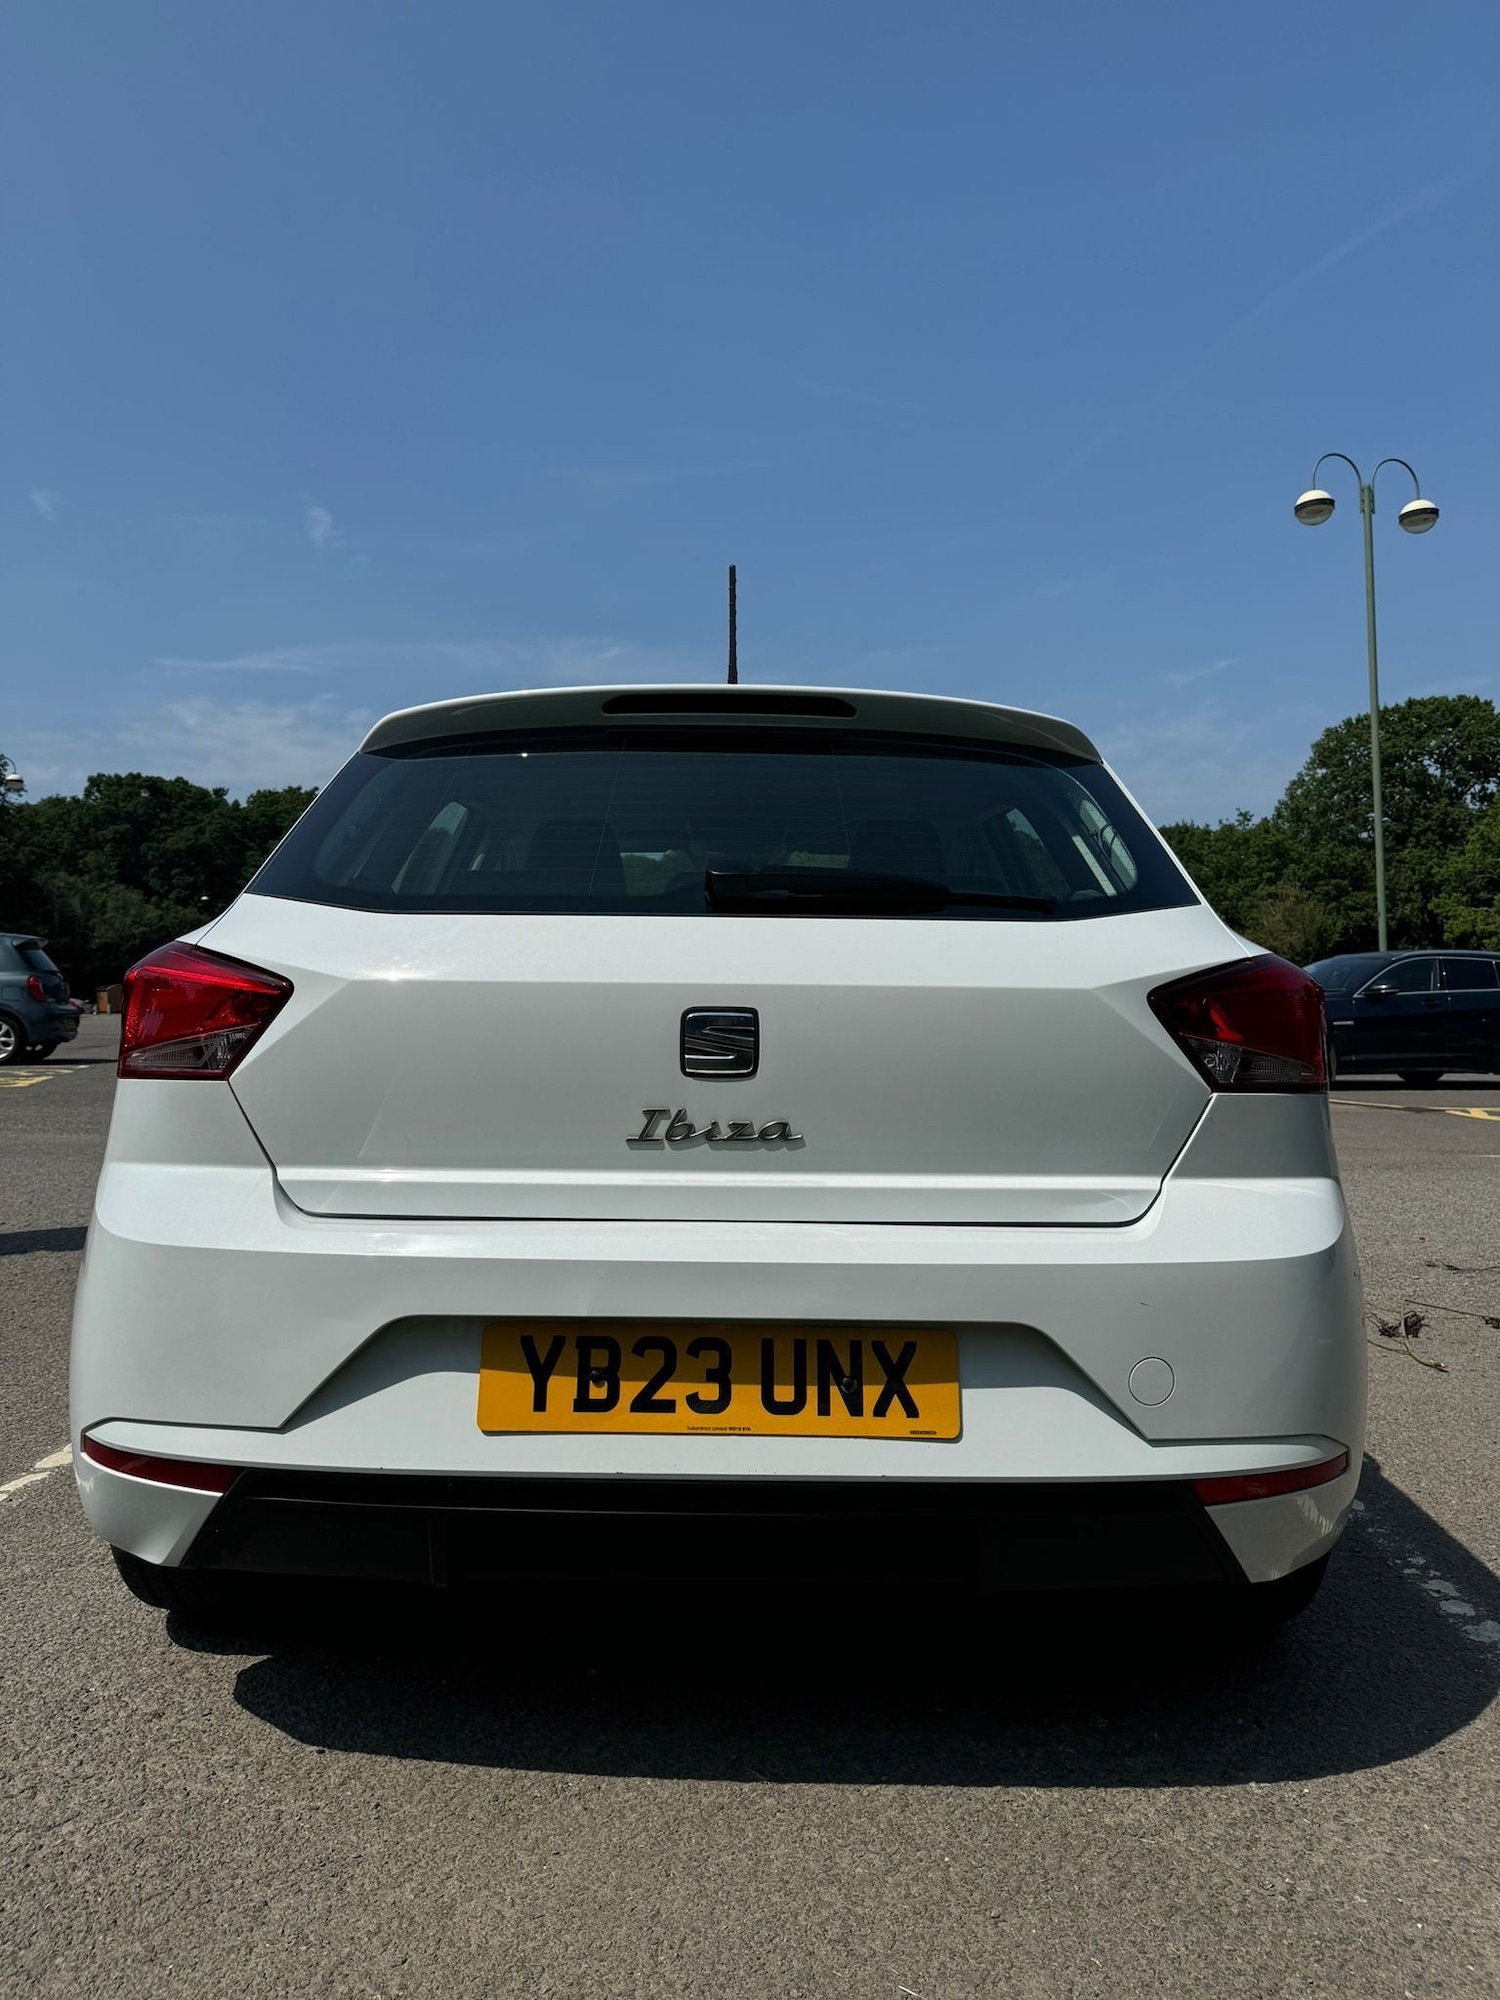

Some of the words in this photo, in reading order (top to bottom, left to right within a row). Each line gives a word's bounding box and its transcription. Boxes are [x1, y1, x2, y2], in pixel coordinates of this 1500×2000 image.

[626, 1108, 803, 1145] Ibiza
[520, 1335, 732, 1414] YB23
[760, 1338, 920, 1419] UNX
